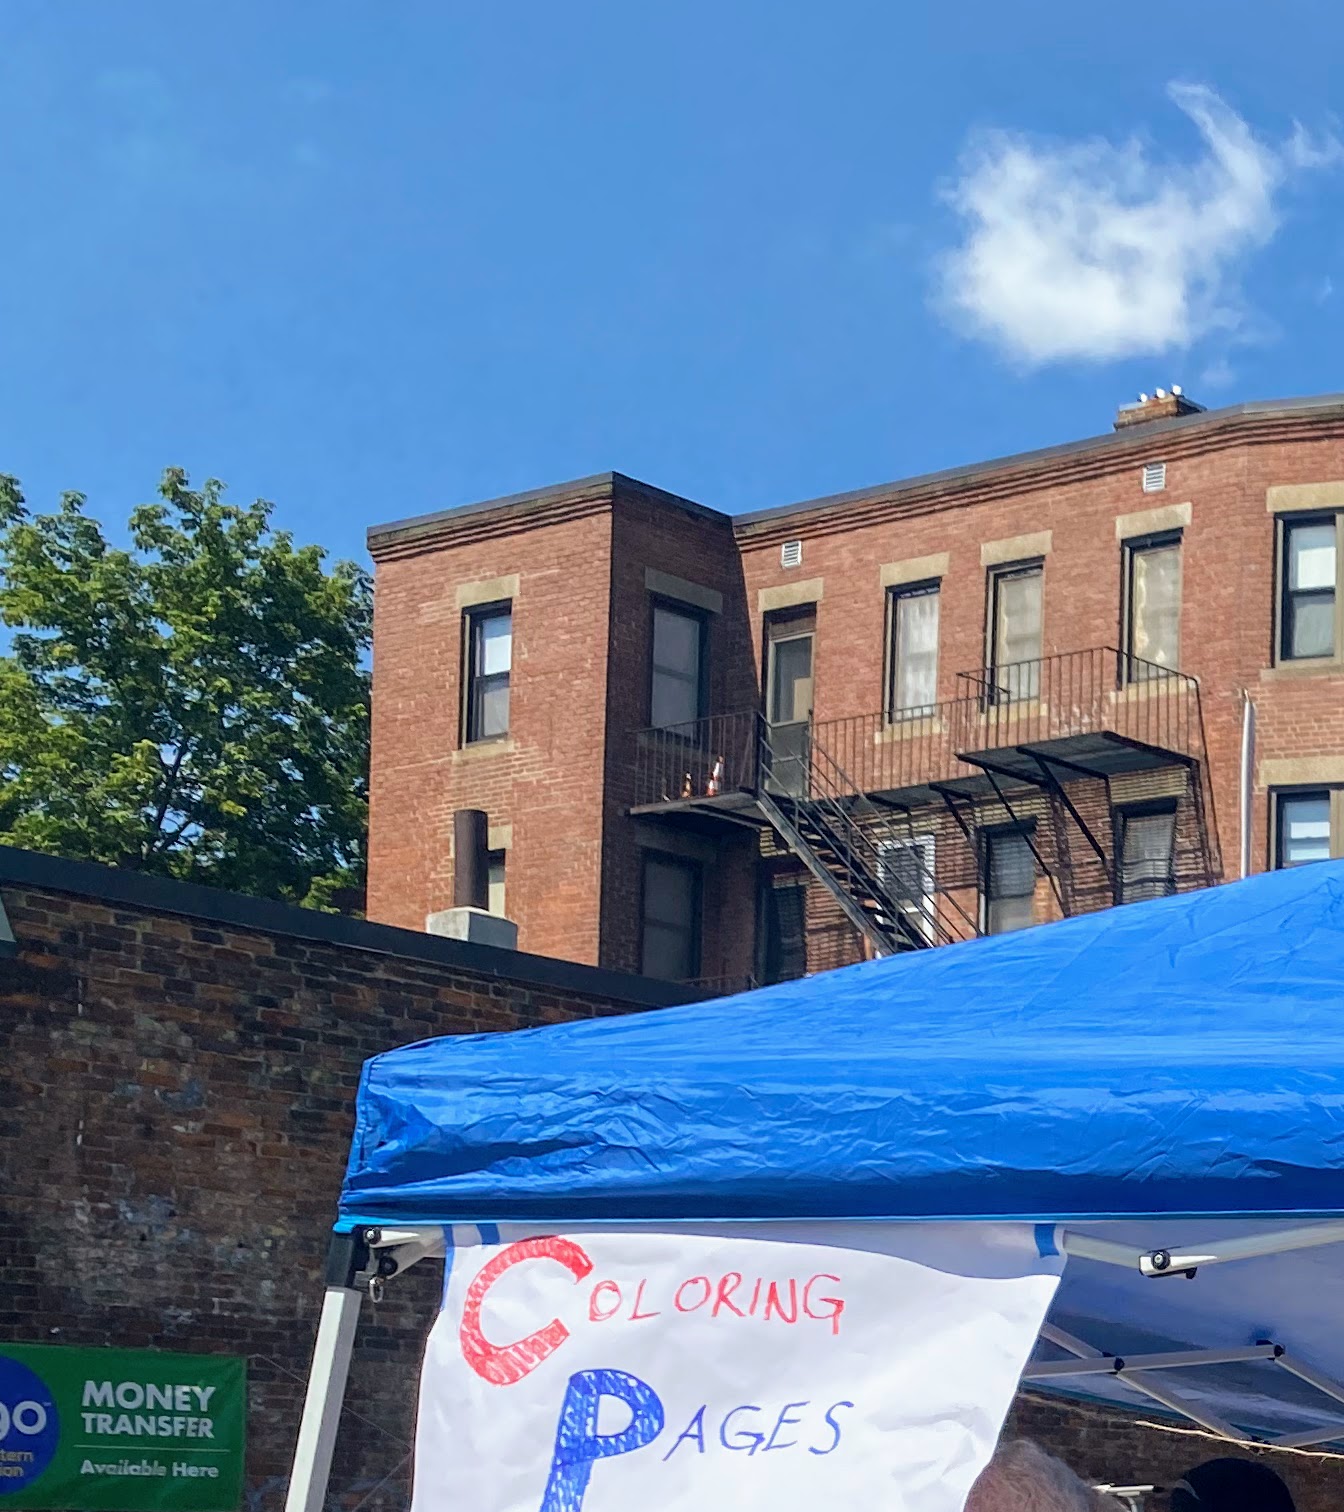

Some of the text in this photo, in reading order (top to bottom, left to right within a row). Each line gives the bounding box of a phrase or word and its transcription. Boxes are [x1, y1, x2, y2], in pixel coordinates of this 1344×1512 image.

[461, 1235, 846, 1386] COLORING
[81, 1380, 216, 1412] MONEY
[81, 1412, 215, 1439] TRANSFER
[80, 1460, 219, 1478] Available Here
